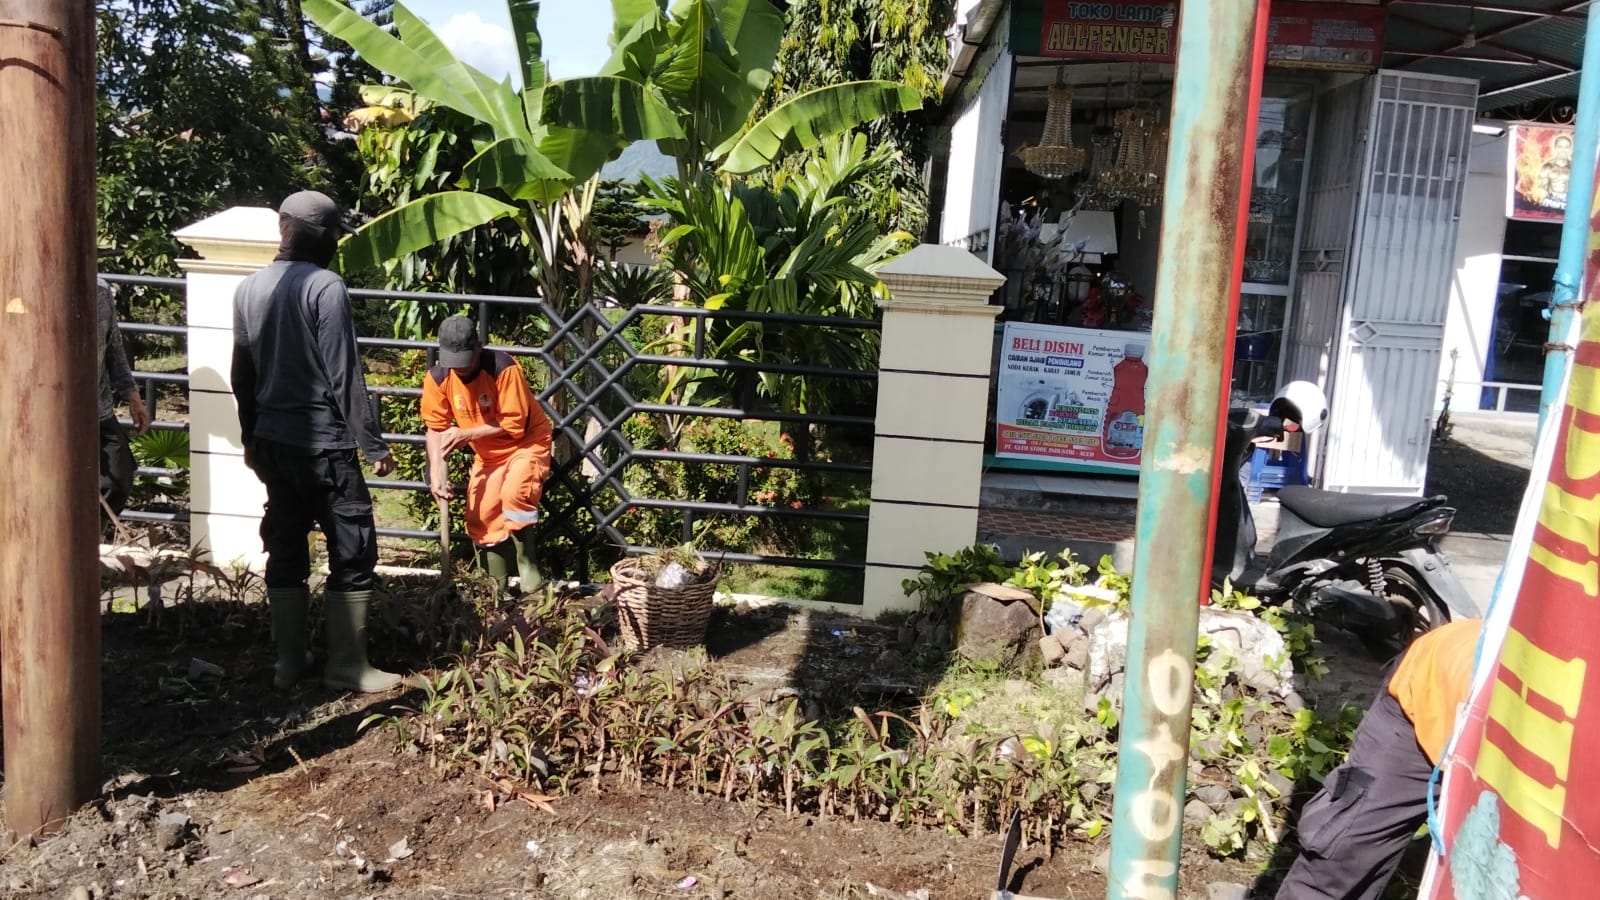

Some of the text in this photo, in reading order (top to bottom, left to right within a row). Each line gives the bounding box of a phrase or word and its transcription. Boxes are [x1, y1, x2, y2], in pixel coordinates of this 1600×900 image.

[1068, 3, 1112, 20] TOKO
[1048, 22, 1171, 55] ALLFENGER
[1012, 337, 1085, 355] BELI DISINI
[1007, 354, 1045, 364] CAIRAN AJAIB
[1043, 367, 1060, 375] KARAT
[1056, 406, 1099, 414] EKONOMIS
